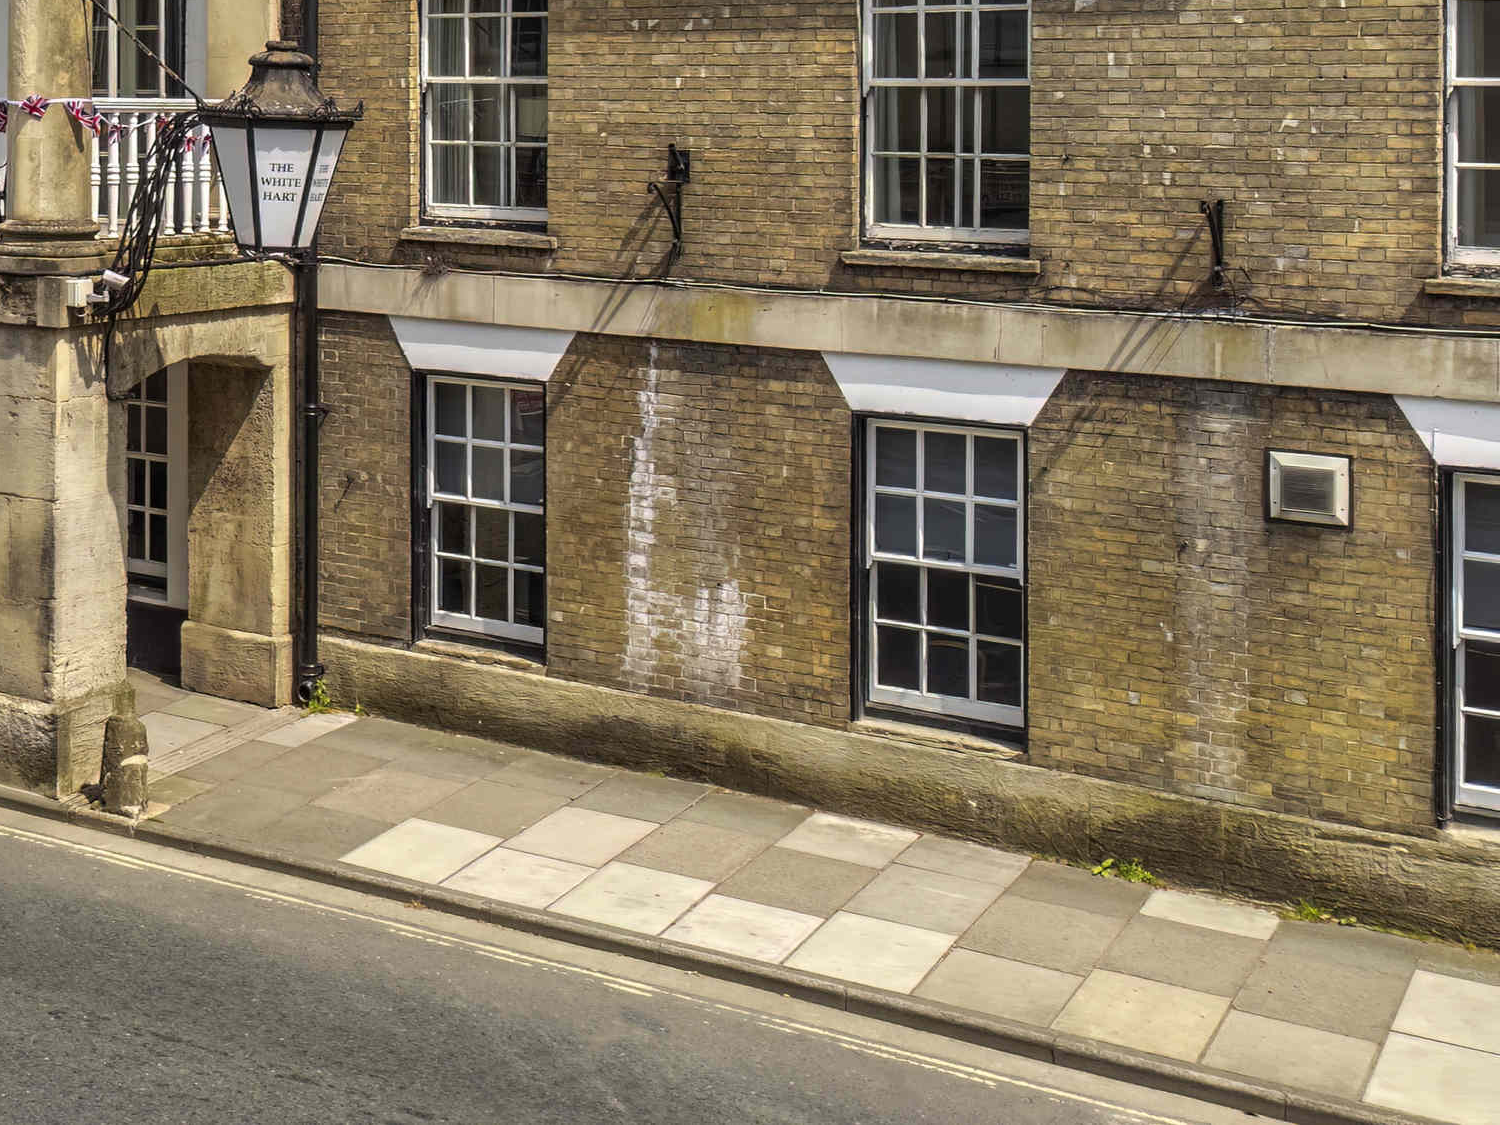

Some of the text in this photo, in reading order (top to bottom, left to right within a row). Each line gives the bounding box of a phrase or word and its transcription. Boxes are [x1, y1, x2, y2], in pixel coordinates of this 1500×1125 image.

[269, 163, 294, 173] THE
[260, 177, 301, 187] WHITE
[263, 191, 297, 201] HART
